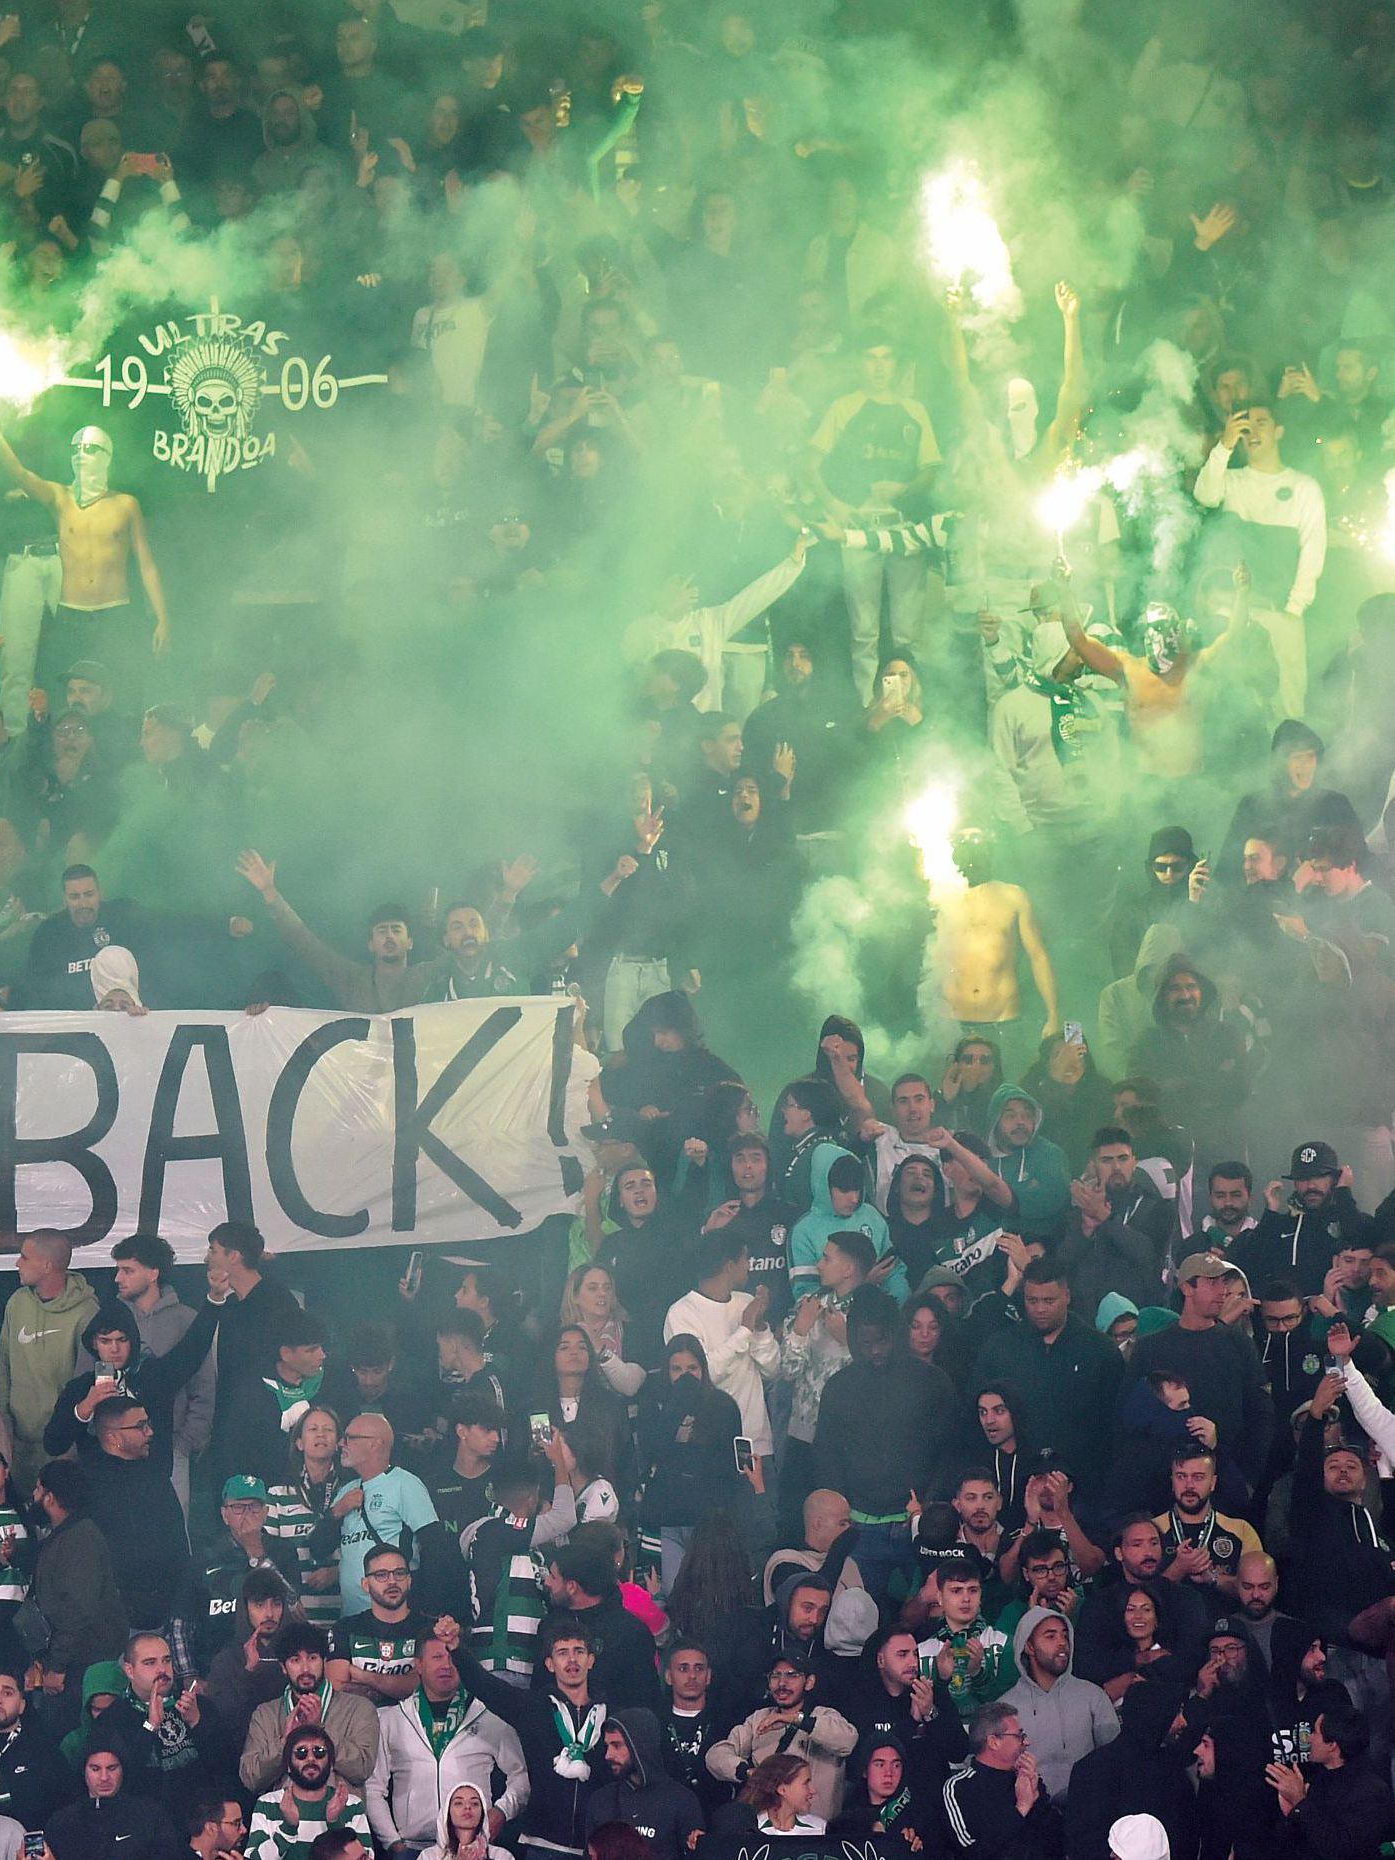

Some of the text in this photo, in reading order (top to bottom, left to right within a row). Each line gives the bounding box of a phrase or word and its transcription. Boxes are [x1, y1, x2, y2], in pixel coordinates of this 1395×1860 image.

[138, 313, 289, 356] ULTRAS
[95, 355, 339, 412] 19 06
[152, 430, 277, 475] BRANDOA
[1300, 1147, 1318, 1164] SCP
[748, 1256, 786, 1272] tano
[939, 1549, 965, 1558] BOCK
[209, 1598, 238, 1616] Bet
